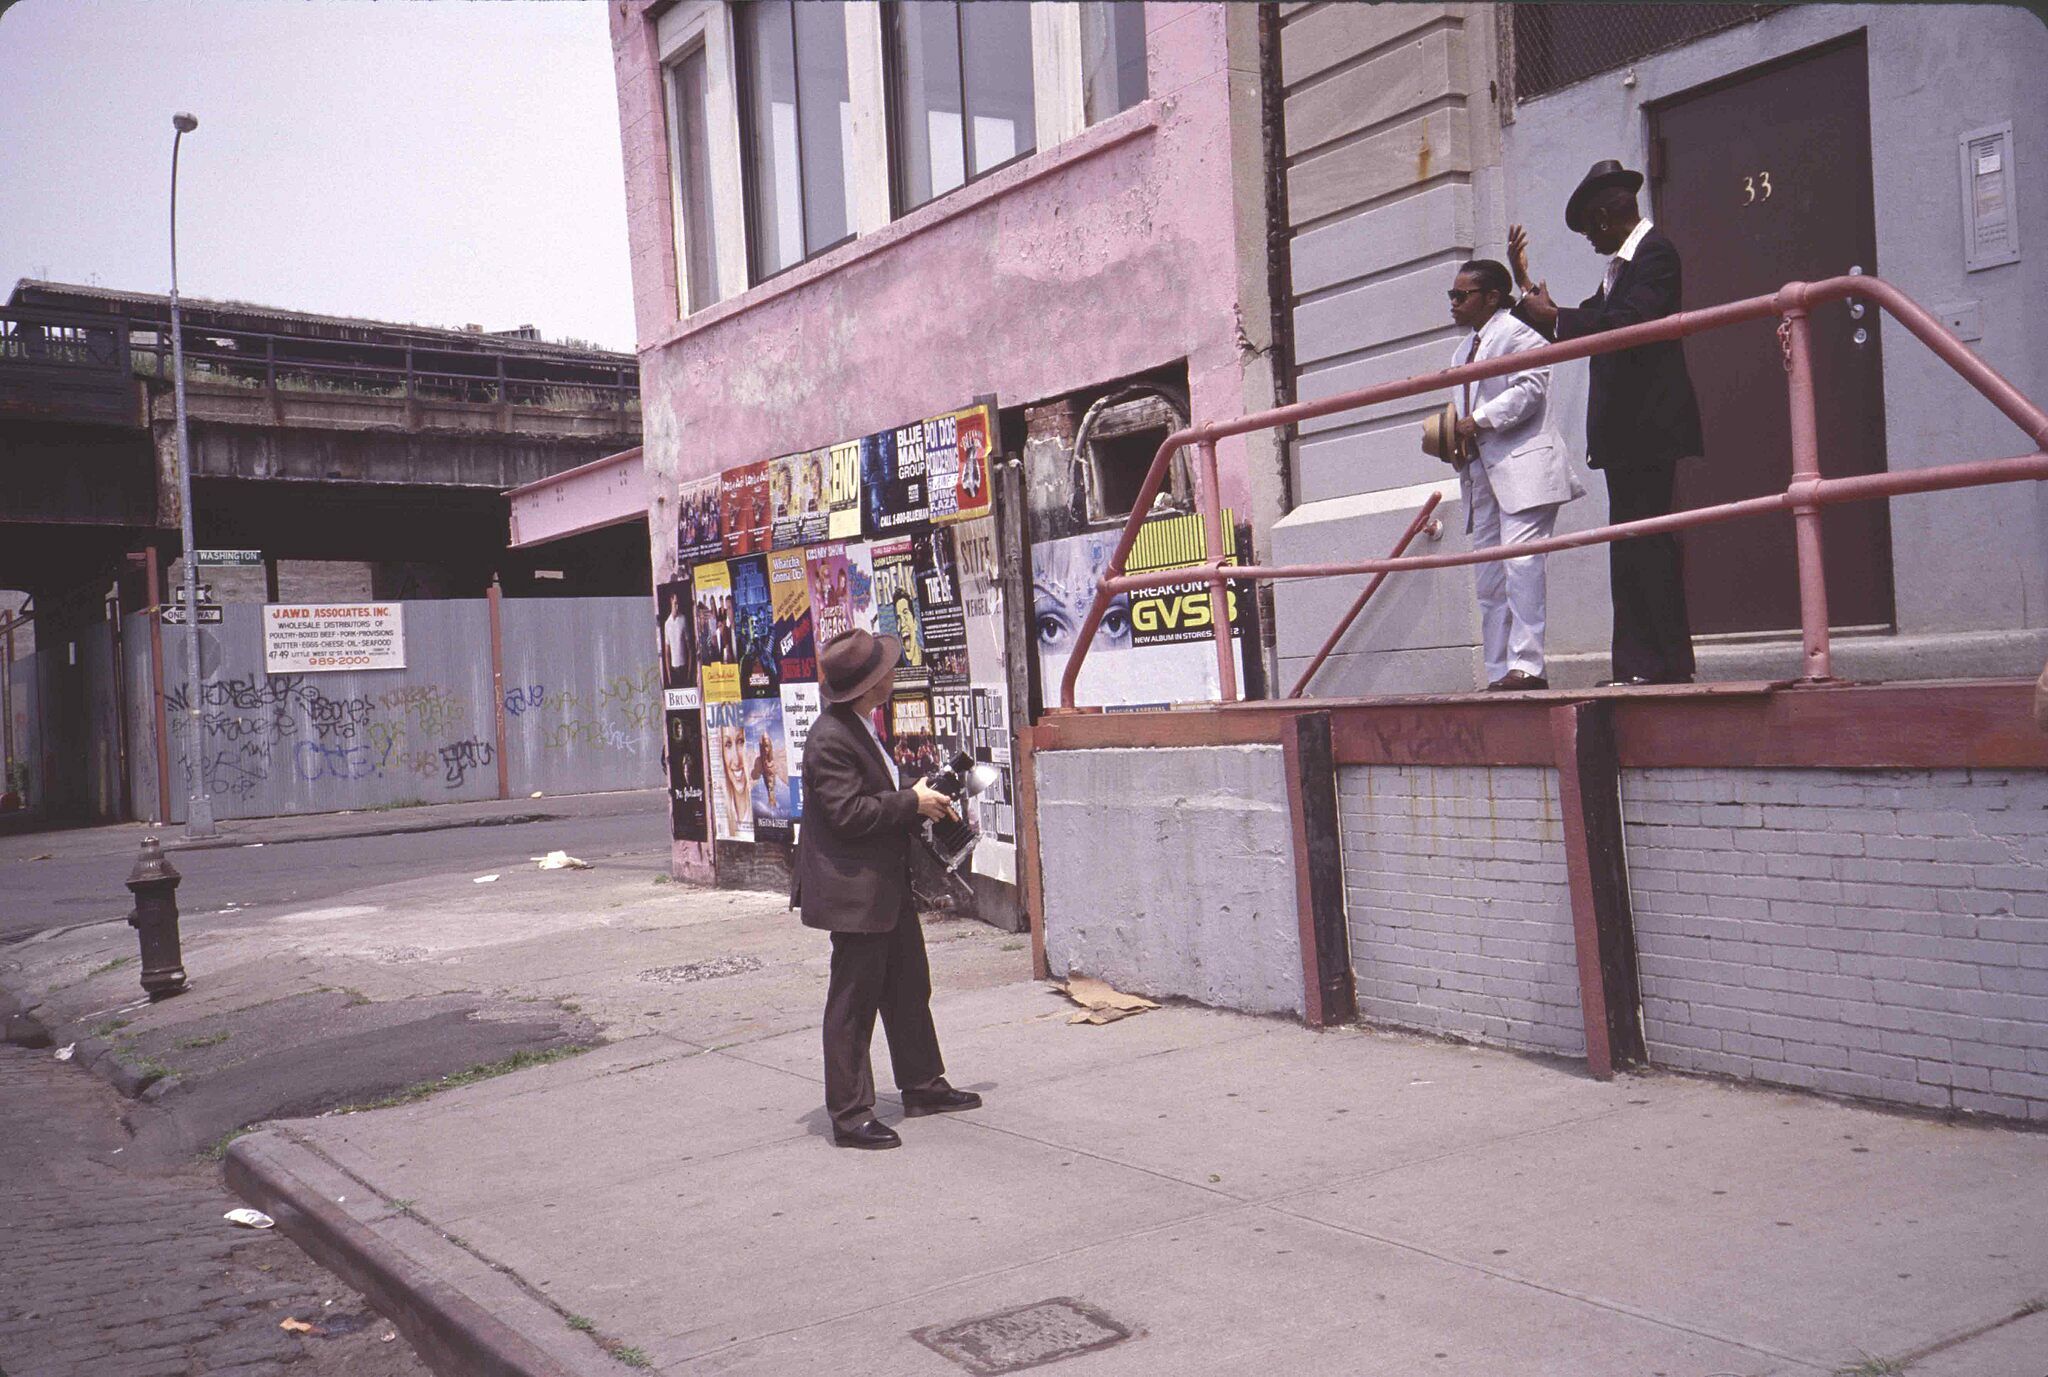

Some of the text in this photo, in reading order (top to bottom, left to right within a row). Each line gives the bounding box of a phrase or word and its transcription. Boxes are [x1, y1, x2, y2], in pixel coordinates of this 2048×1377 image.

[1743, 171, 1772, 206] 33
[896, 425, 923, 448] BLUE
[938, 416, 956, 446] DOG
[897, 442, 924, 467] MAN
[898, 462, 926, 480] GROUP
[880, 514, 892, 527] CALL
[200, 551, 257, 560] WASHINGTON
[167, 611, 216, 620] ONE WAY
[1131, 590, 1238, 631] GVSB
[323, 621, 371, 629] DISTRIBUTORS
[1181, 630, 1212, 639] STORES
[309, 657, 370, 665] 989-2000
[668, 692, 697, 707] BRUNO
[933, 694, 970, 715] BEST
[706, 703, 744, 728] JANE
